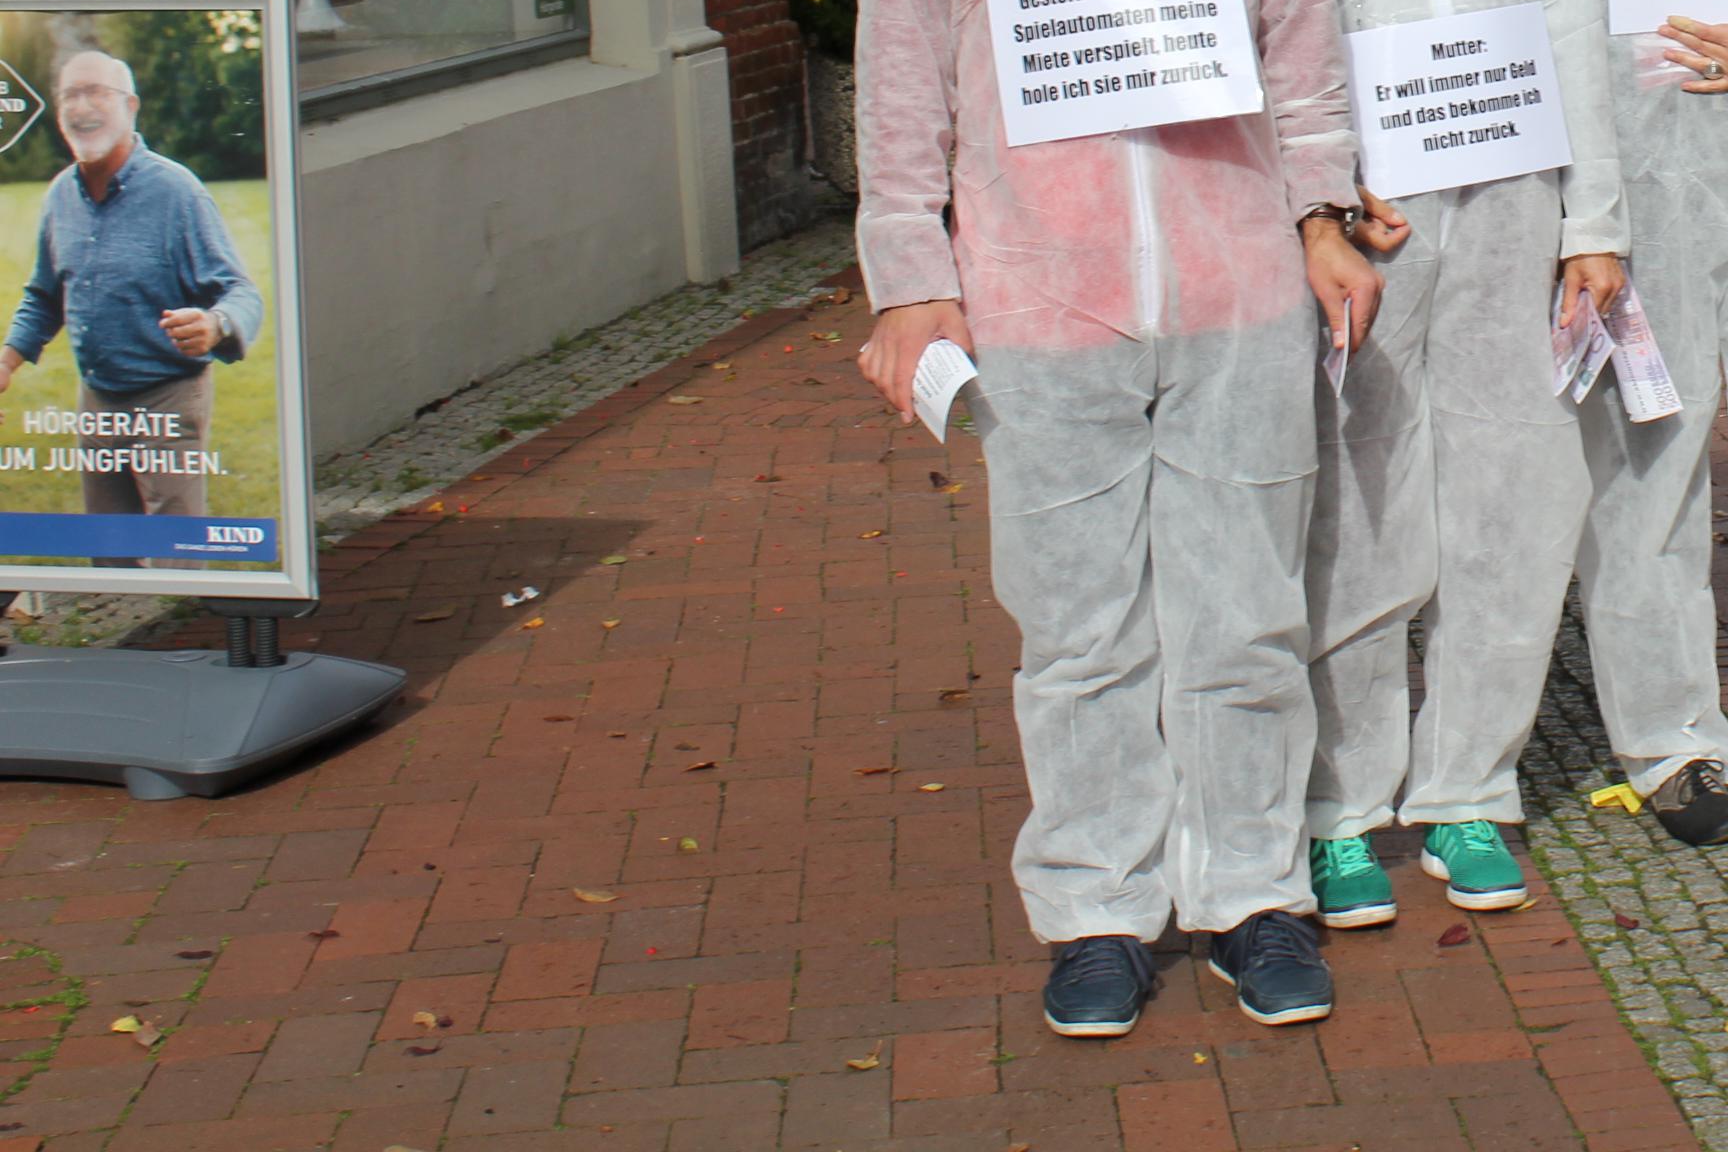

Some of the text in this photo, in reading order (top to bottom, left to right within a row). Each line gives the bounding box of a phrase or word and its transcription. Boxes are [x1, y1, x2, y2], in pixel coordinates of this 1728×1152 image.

[1014, 1, 1218, 43] Spielautomaten meine
[1023, 31, 1217, 74] Miete verspielt, heute
[1431, 39, 1488, 61] Mutter:
[1021, 59, 1228, 106] hole ich sie mir zurück.
[1375, 60, 1538, 102] Er will immer nur Geld
[1380, 88, 1542, 130] und das bekomme ich
[1423, 121, 1520, 152] nicht zurück.
[24, 406, 182, 438] HÖRGERÄTE
[43, 444, 228, 475] JUNGFÜHLEN.
[206, 526, 265, 544] KIND
